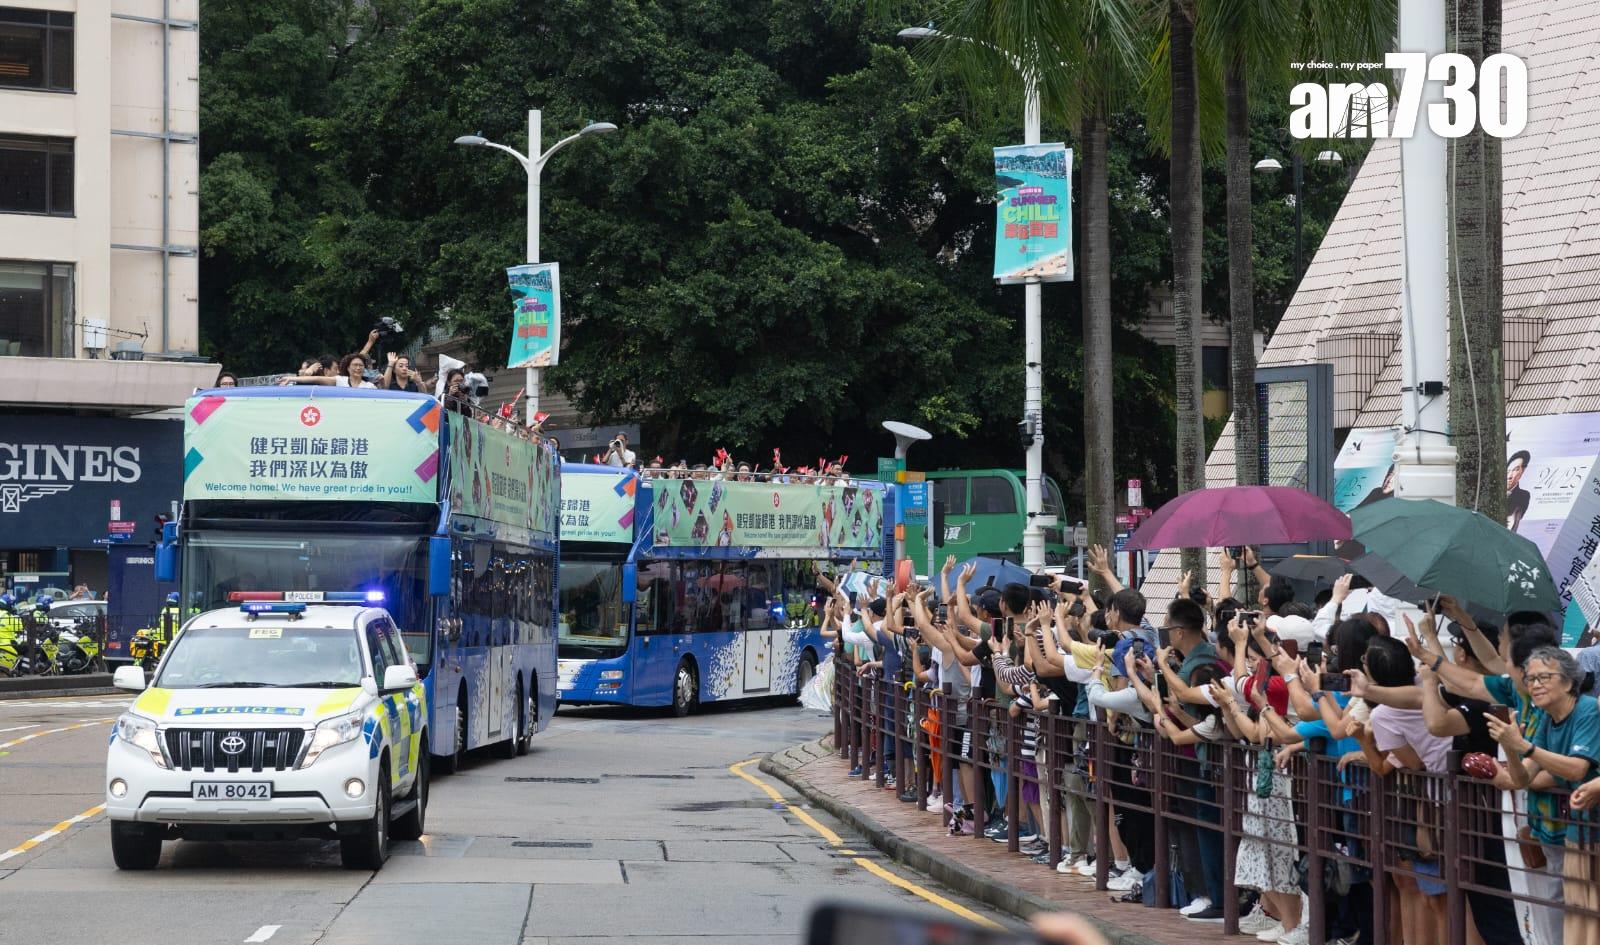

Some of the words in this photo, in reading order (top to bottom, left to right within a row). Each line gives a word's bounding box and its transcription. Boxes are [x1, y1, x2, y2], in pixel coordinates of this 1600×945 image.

[1011, 195, 1057, 206] SUMMER
[1003, 204, 1060, 223] CHILL
[250, 436, 369, 456] 健兒凱旋歸港
[250, 460, 368, 479] 我們深以為傲
[205, 483, 247, 492] Welcome
[250, 483, 279, 492] home!
[281, 483, 297, 492] We
[299, 484, 321, 492] have
[323, 484, 347, 494] great
[350, 484, 374, 494] pride
[377, 485, 385, 493] in
[388, 485, 413, 494] you!!
[295, 591, 314, 600] POLICE
[202, 706, 276, 714] POLICE
[198, 785, 218, 798] AM
[225, 785, 268, 798] 8042
